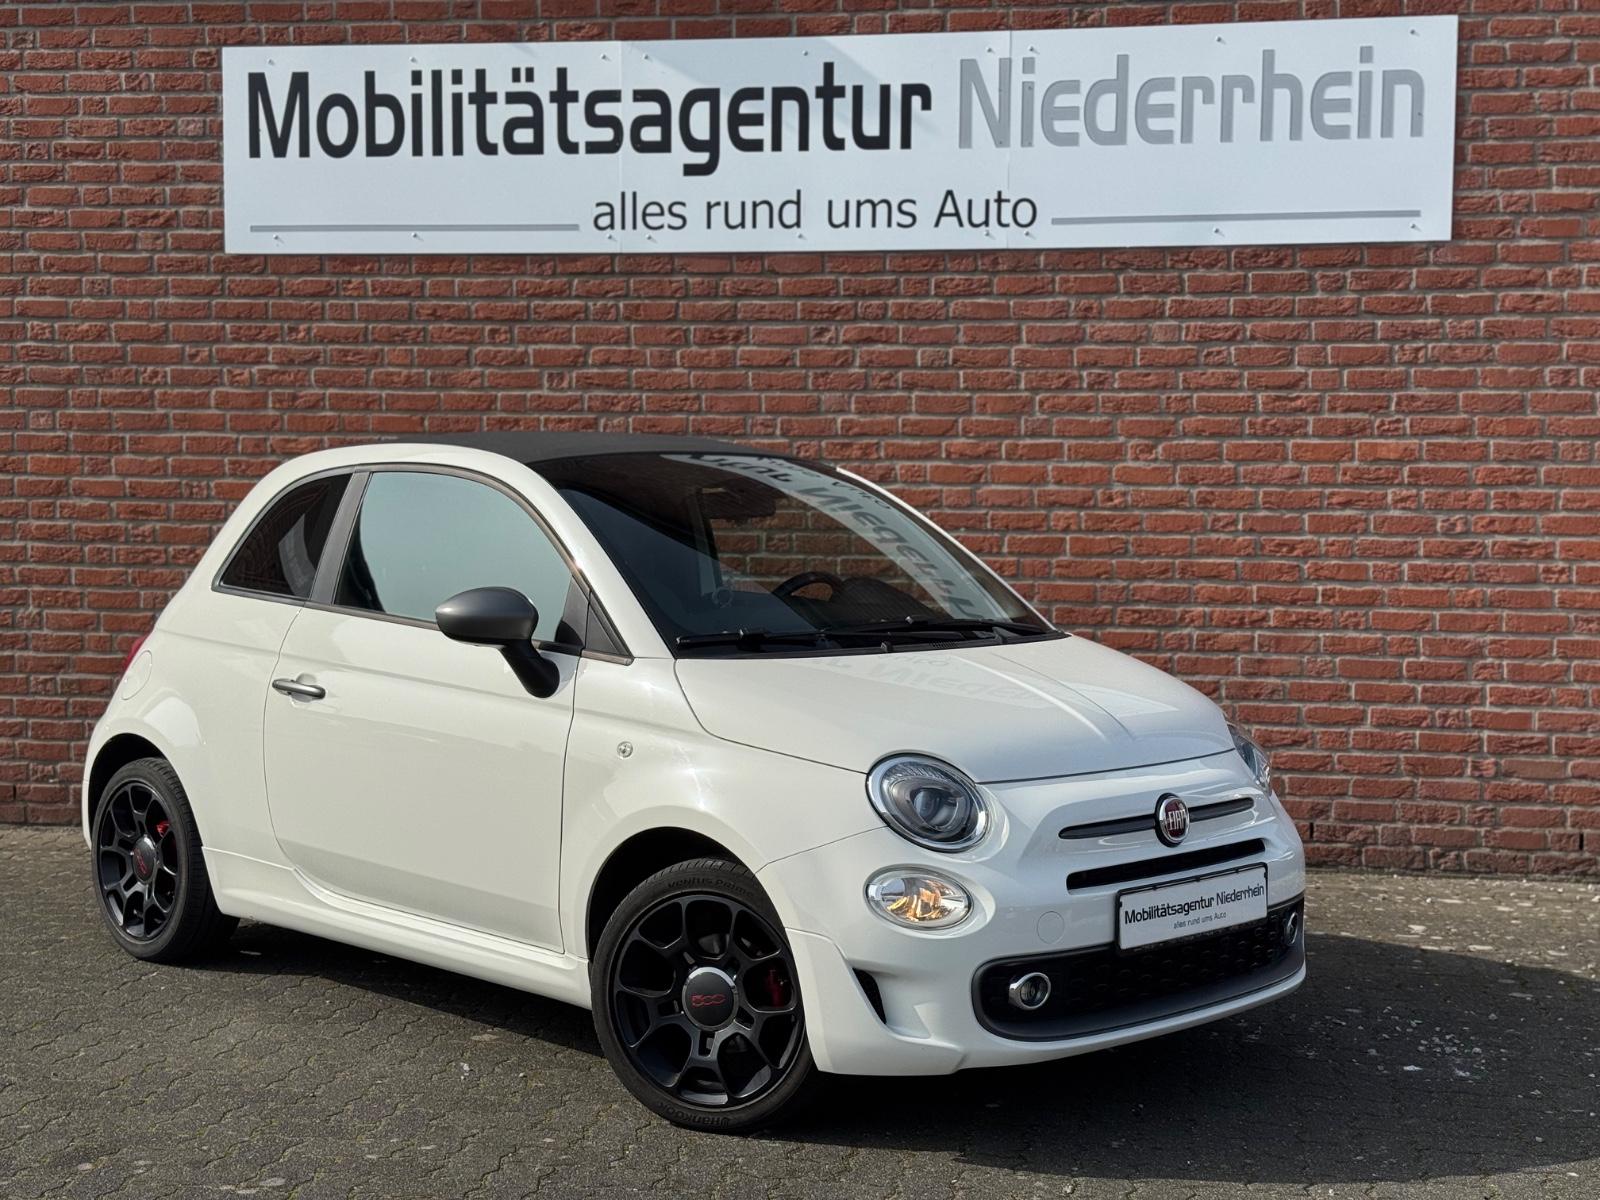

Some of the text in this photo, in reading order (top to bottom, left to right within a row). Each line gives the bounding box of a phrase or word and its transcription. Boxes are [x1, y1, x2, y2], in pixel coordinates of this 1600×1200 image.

[248, 45, 1425, 177] Mobilitätsagentur Niederrhein
[593, 189, 1038, 231] alles rund ums Auto
[1168, 809, 1186, 831] FIAT
[1124, 883, 1265, 925] Mobilitätsagentur Niederrhein
[1173, 911, 1227, 930] alles rund ums Auto
